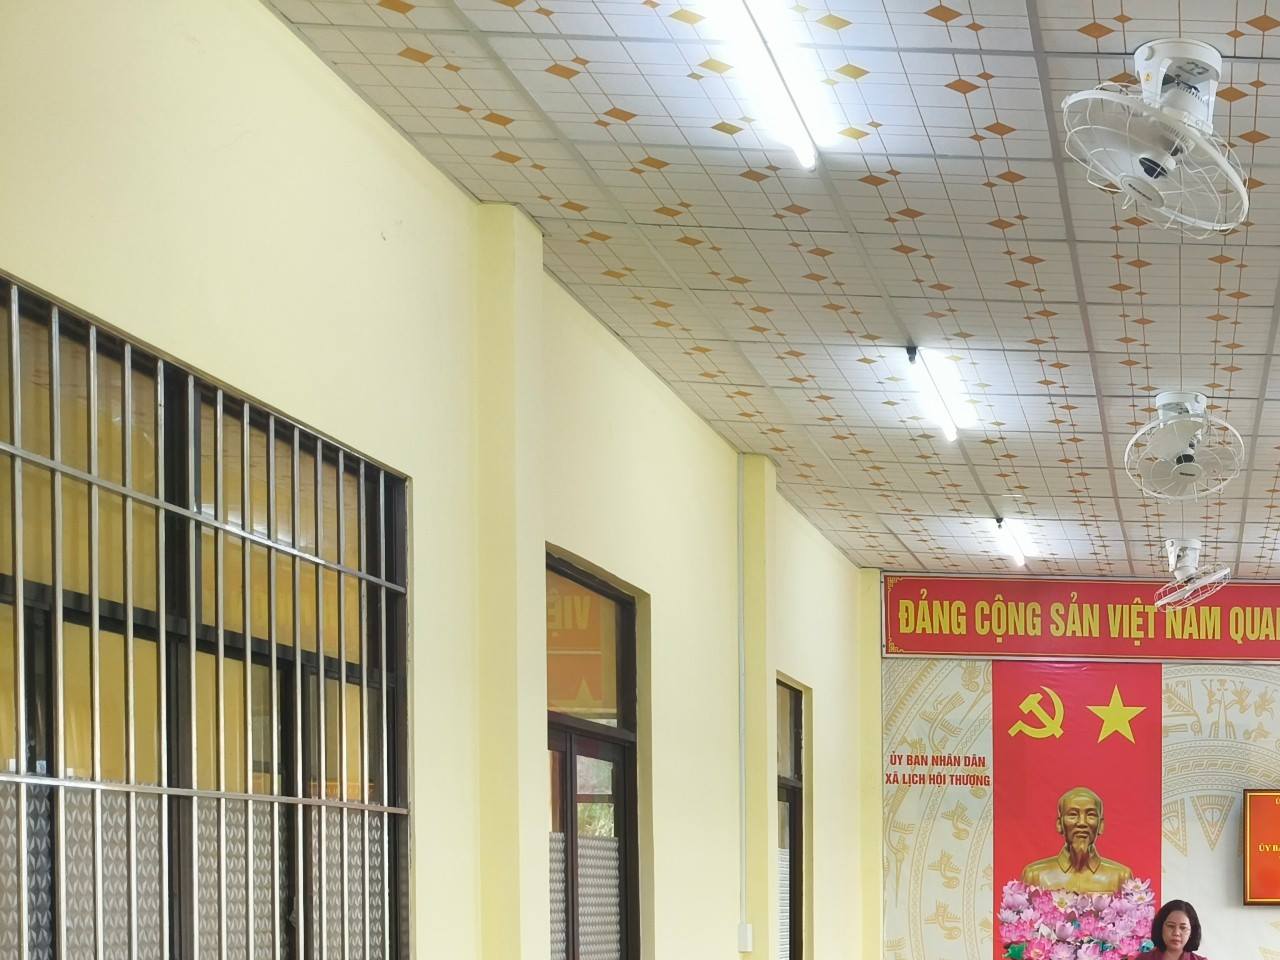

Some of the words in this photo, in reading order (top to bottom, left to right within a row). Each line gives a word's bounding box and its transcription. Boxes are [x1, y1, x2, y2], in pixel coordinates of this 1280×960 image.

[898, 588, 967, 634] ĐẢNG
[974, 594, 1042, 644] CỘNG
[1050, 592, 1100, 637] SẢN
[1107, 597, 1158, 646] VIỆT
[1165, 604, 1221, 640] NAM
[890, 750, 904, 766] ỦY
[906, 754, 929, 767] BAN
[931, 753, 961, 767] NHÂN
[963, 753, 986, 768] DÂN
[885, 771, 900, 785] XÃ
[902, 773, 926, 788] LỊCH
[928, 772, 947, 788] HỘI
[949, 774, 991, 789] THƯỢNG
